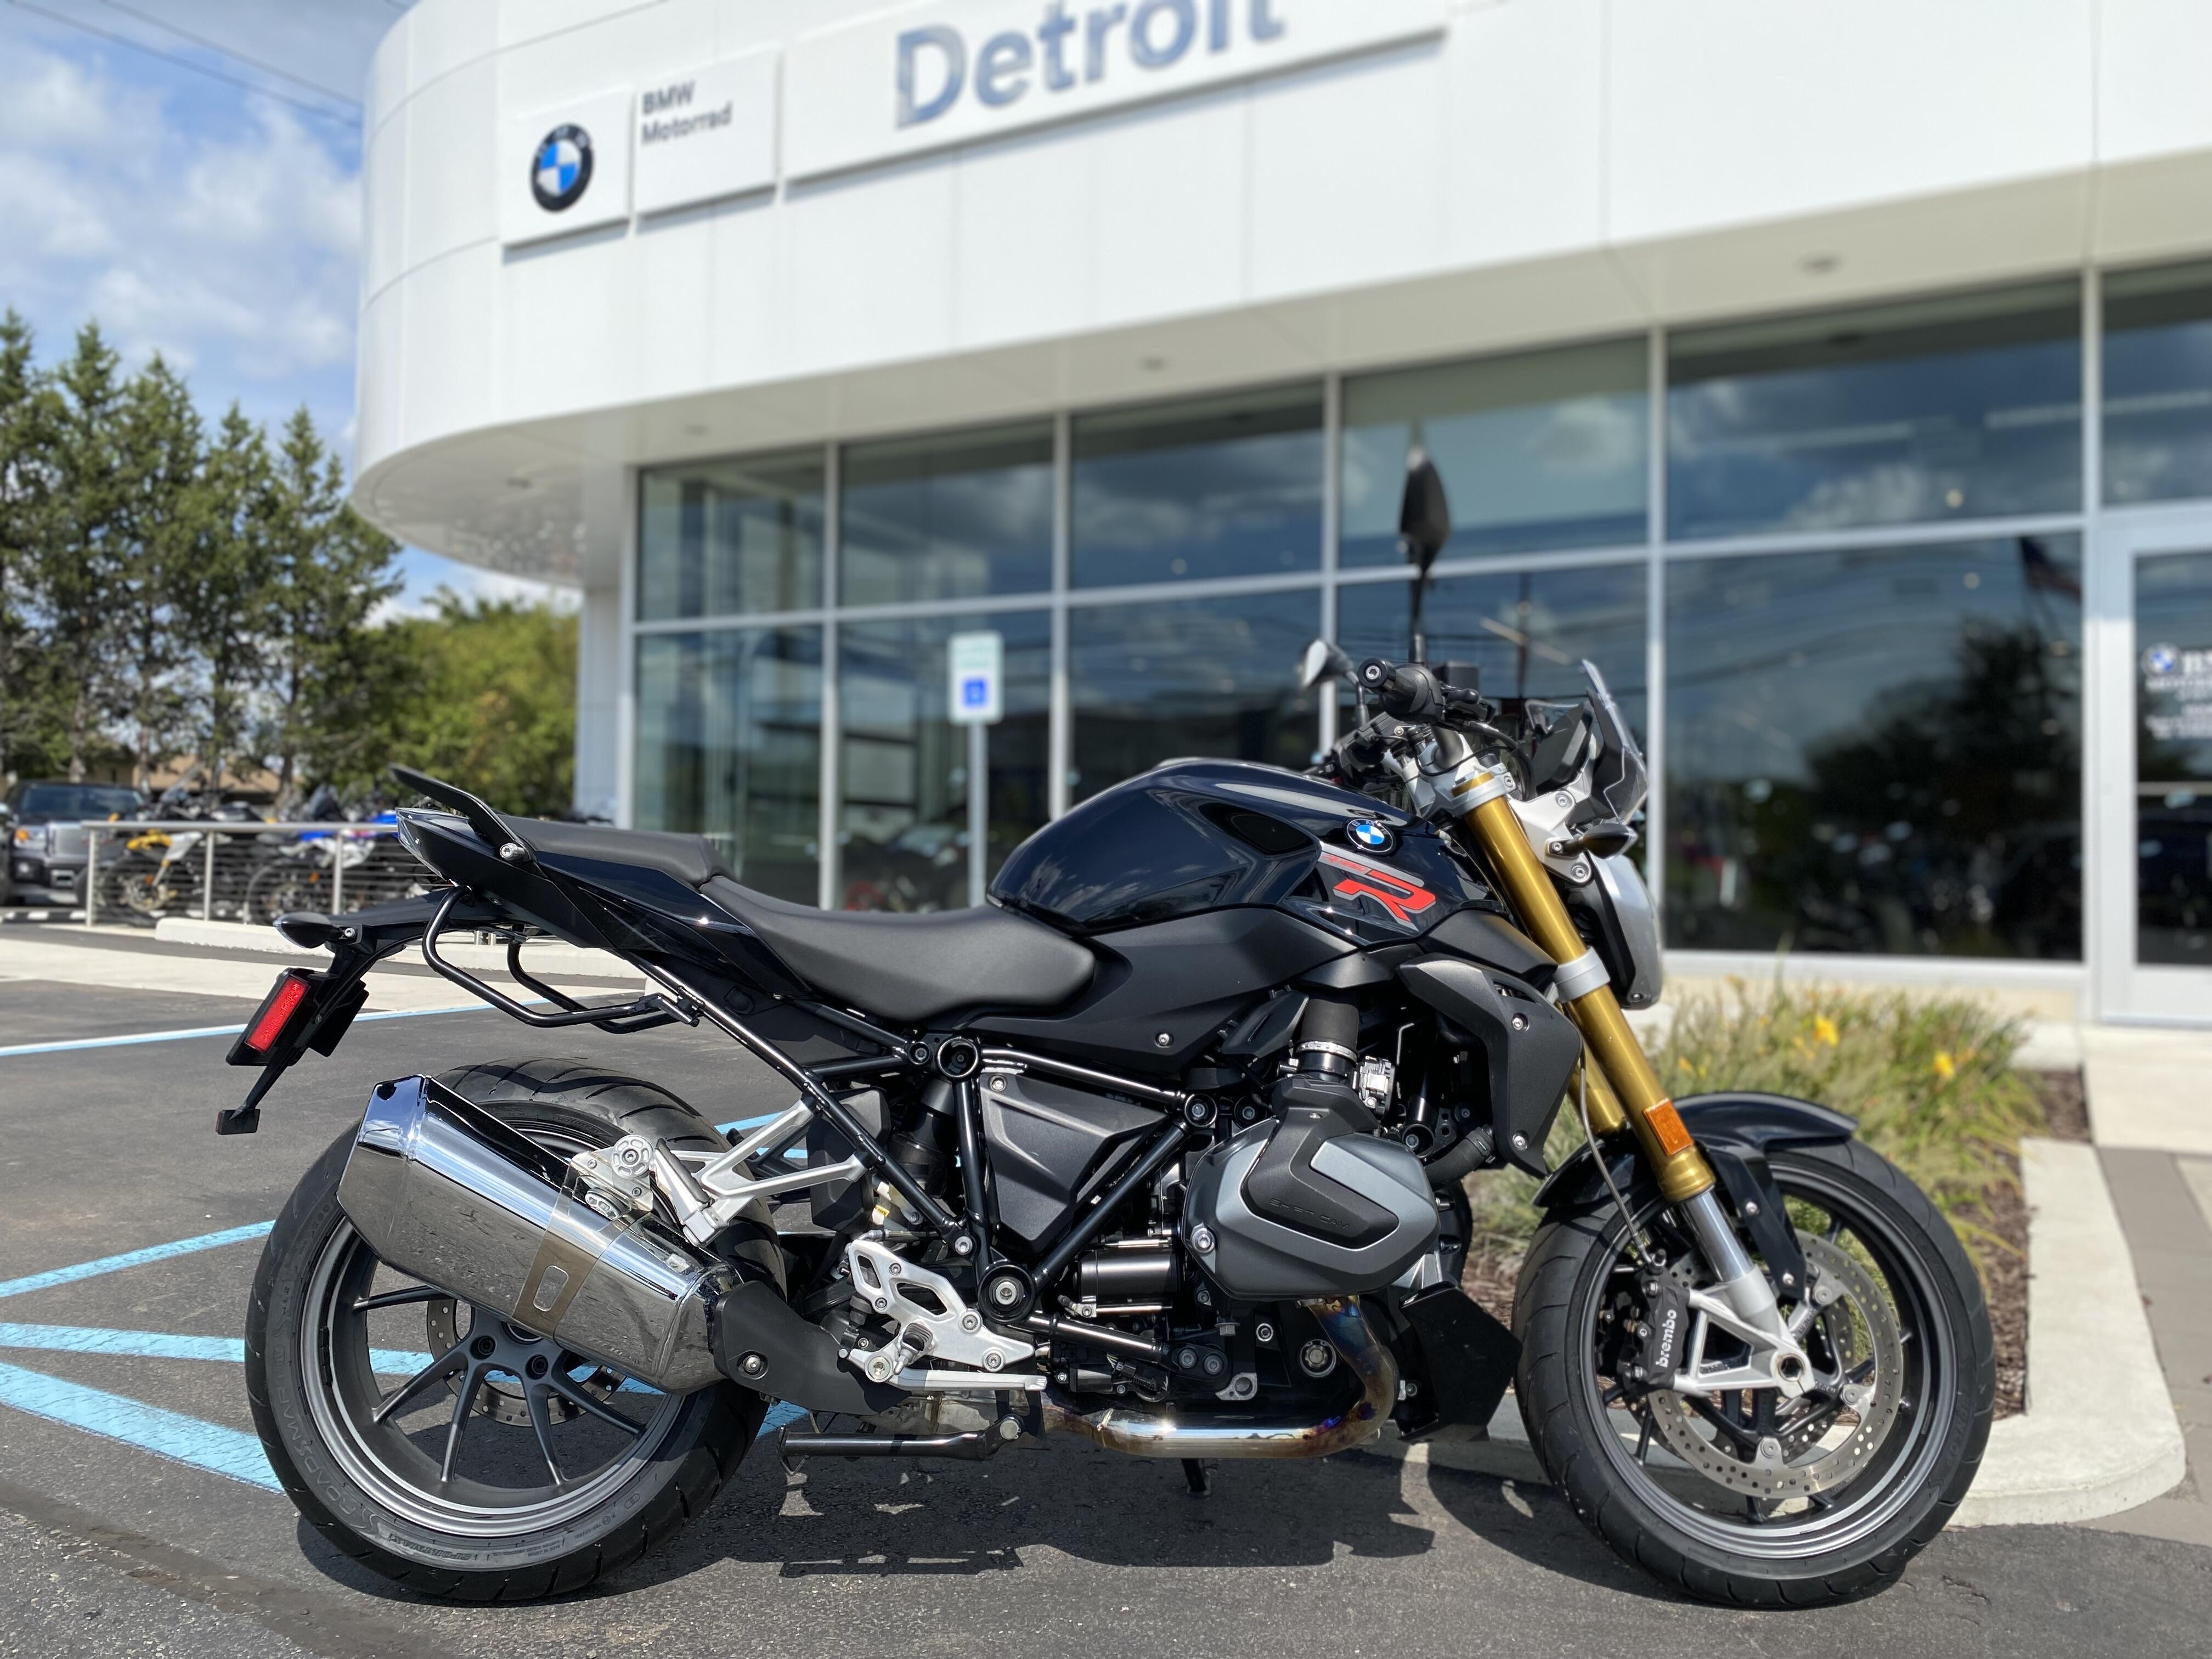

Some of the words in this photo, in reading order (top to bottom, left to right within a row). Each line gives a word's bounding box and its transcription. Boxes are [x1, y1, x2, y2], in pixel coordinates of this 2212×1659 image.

[642, 81, 695, 114] BMW
[642, 100, 733, 146] Motorrad
[1269, 1198, 1315, 1215] SHIFT
[1319, 1214, 1350, 1229] CAM
[1655, 1310, 1677, 1368] brembo
[391, 1534, 472, 1561] SPORTMAX
